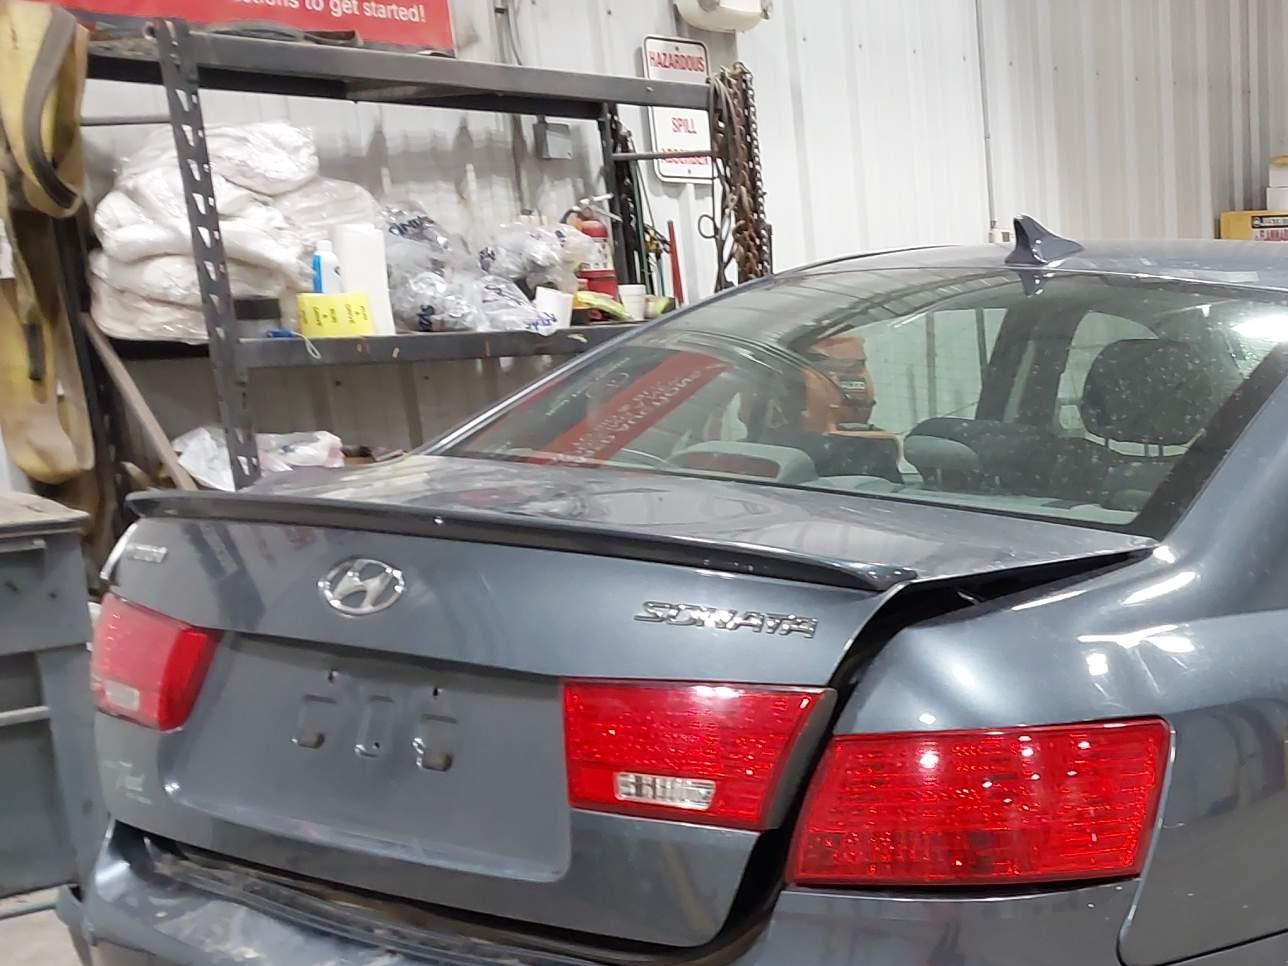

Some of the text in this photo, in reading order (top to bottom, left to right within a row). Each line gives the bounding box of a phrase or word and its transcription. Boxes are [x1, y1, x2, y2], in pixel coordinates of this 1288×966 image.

[304, 0, 325, 11] to
[329, 0, 360, 17] get
[362, 1, 426, 22] started!
[648, 51, 705, 72] HAZARDOUS
[671, 117, 698, 134] SPILL
[633, 600, 819, 639] SONATA
